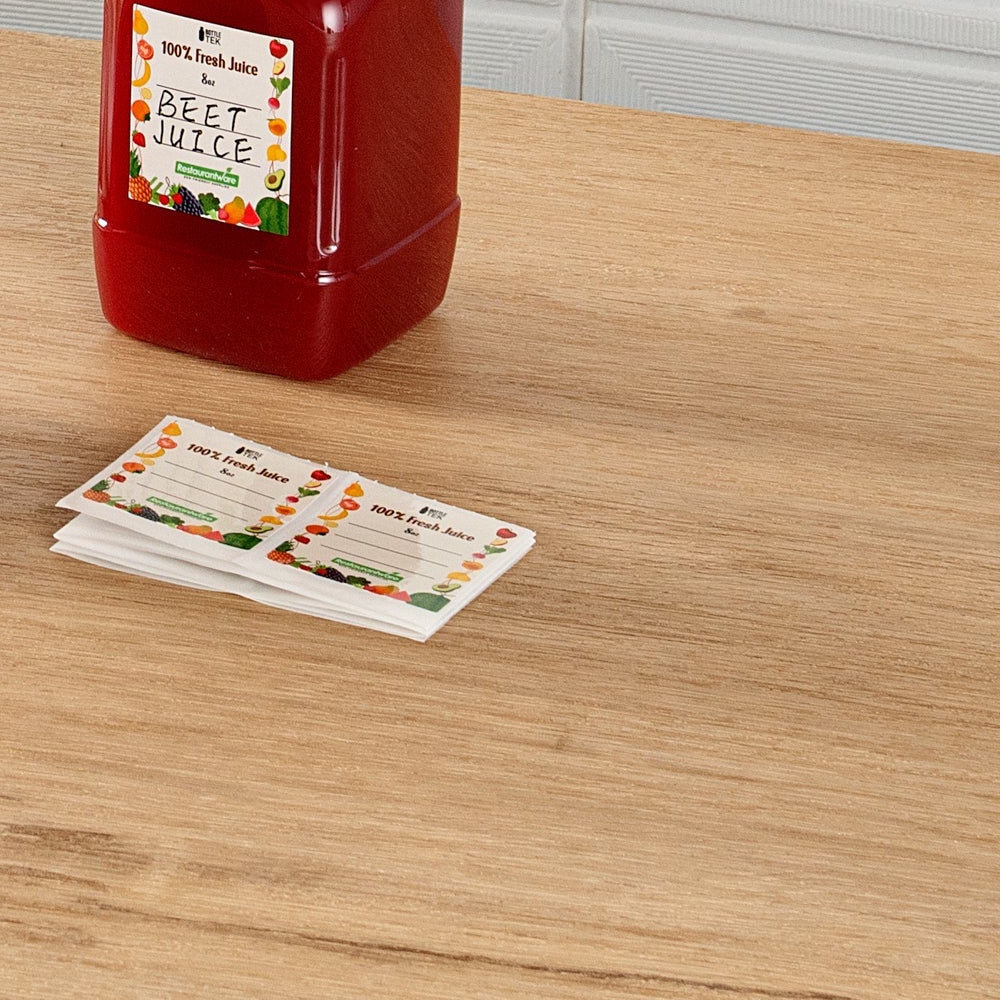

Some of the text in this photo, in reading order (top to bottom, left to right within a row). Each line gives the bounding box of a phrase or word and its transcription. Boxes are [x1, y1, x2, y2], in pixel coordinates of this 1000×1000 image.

[161, 40, 258, 76] 100% Fresh Juice
[205, 36, 221, 46] TEK
[201, 72, 215, 87] 8oz
[157, 89, 246, 132] BEET
[153, 120, 252, 163] JUICE
[177, 163, 237, 185] Restaurantware
[187, 443, 290, 484] 100% Fresh Juice
[370, 504, 475, 541] 100% Fresh Juice
